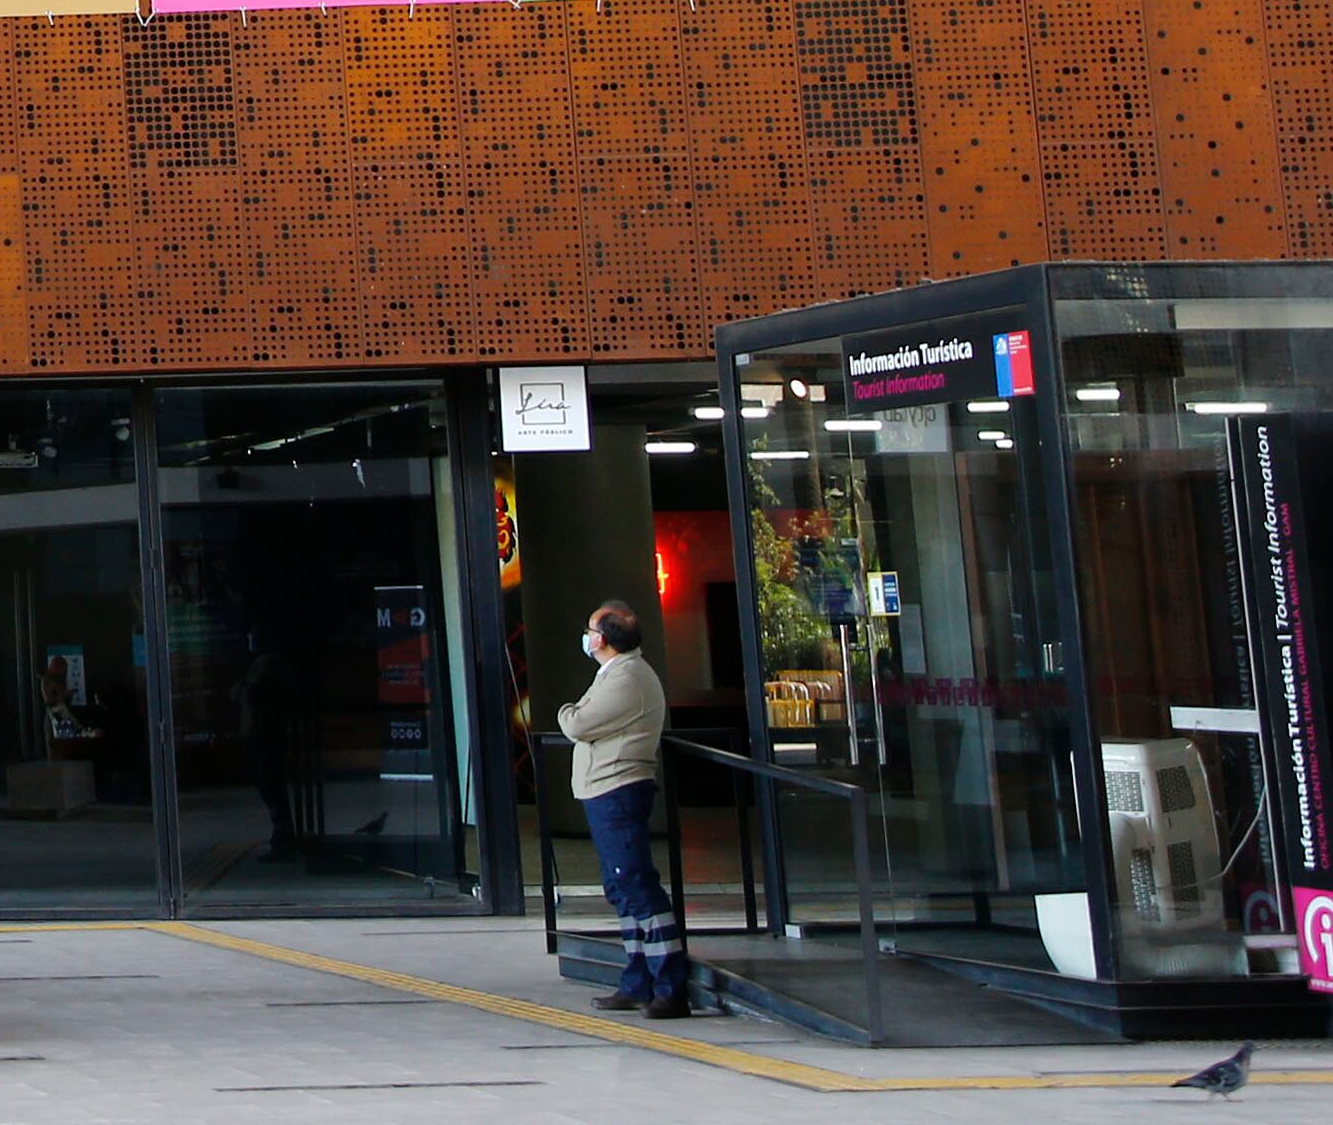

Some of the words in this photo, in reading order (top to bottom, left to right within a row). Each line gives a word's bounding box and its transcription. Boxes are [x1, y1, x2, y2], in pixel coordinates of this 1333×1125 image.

[849, 345, 920, 376] Información
[919, 337, 973, 365] Turística
[853, 377, 886, 400] Tourist
[886, 371, 945, 395] Information
[1257, 426, 1282, 555] Information
[1280, 502, 1293, 537] GAM
[1270, 556, 1289, 630] Tourist
[1284, 548, 1301, 606] MISTRAL
[1292, 609, 1309, 676] GABRIELA
[1281, 645, 1301, 737] Turística
[1301, 678, 1318, 751] CULTURAL
[1290, 736, 1316, 870] Información
[1307, 752, 1324, 810] CENTRO
[1313, 812, 1330, 871] OFICINA
